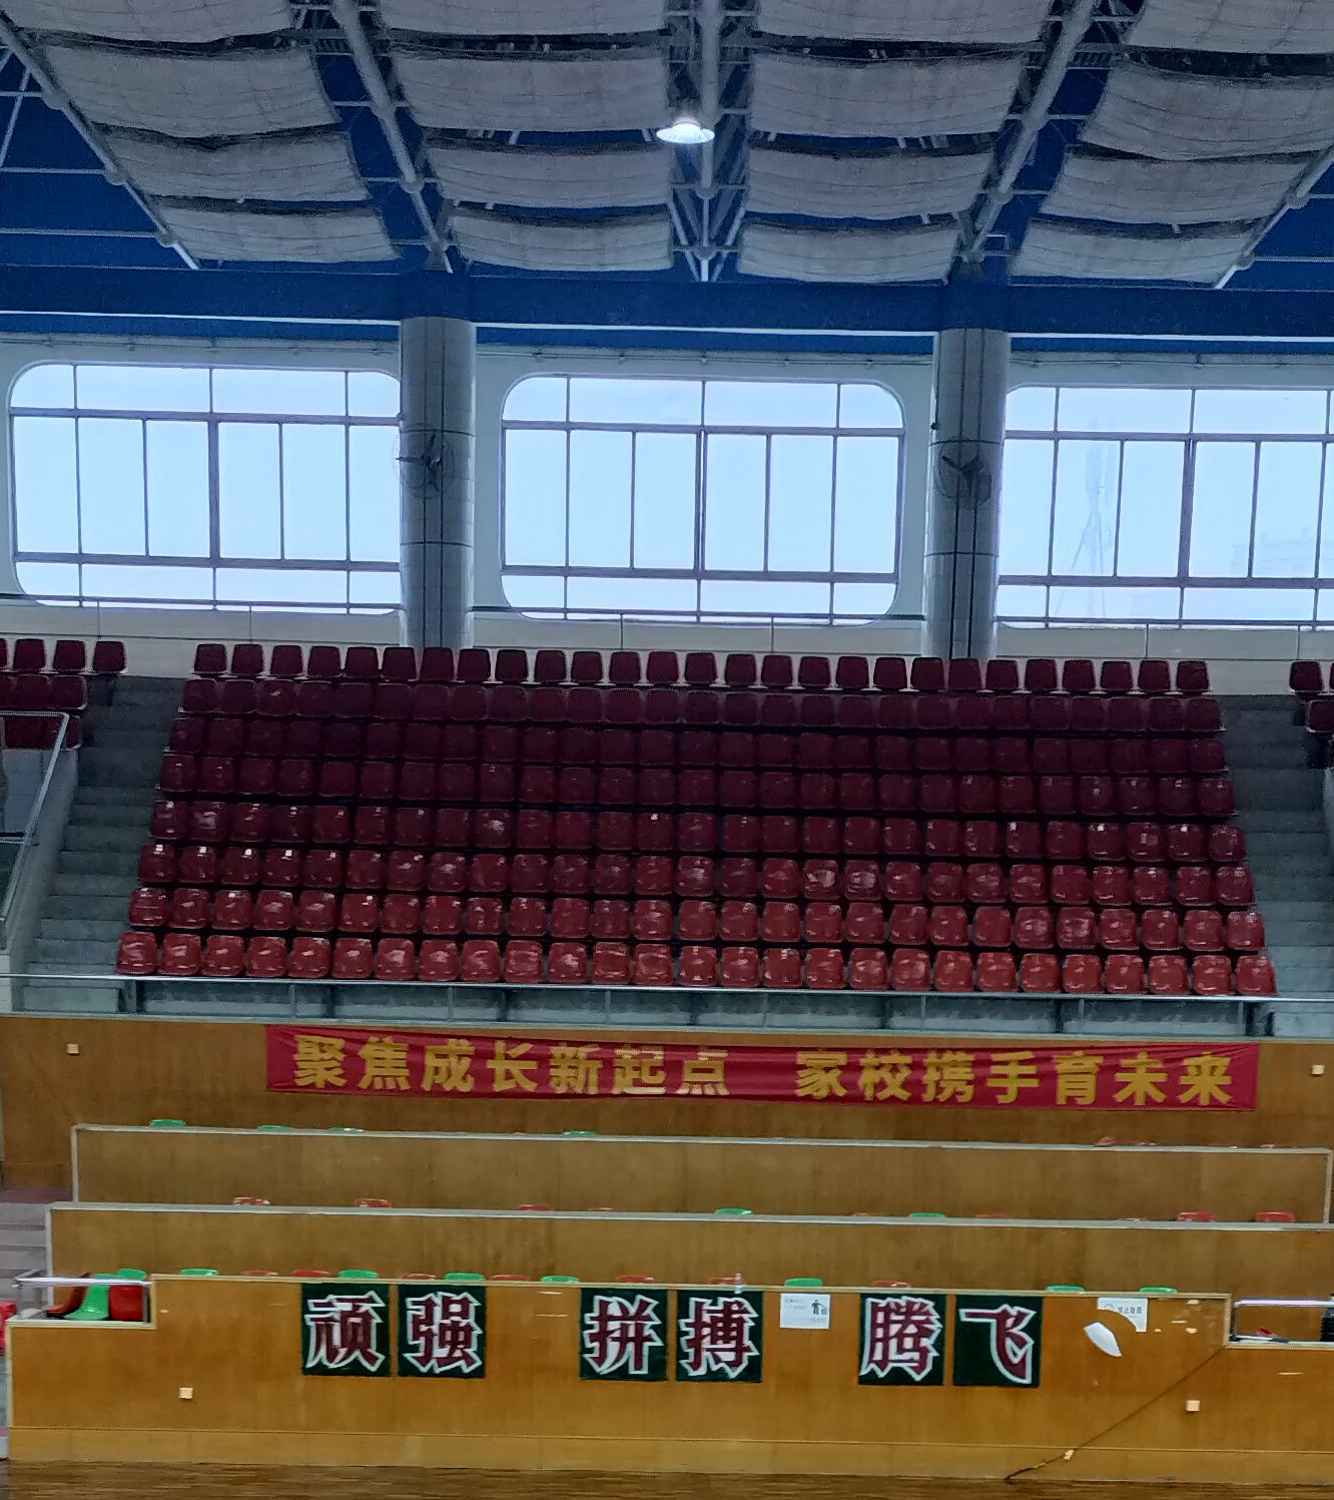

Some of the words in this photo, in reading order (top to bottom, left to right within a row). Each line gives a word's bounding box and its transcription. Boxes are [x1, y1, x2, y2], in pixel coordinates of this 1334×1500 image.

[292, 1034, 731, 1096] 聚焦成长新起点
[794, 1049, 1233, 1105] 家校携手育未来
[303, 1290, 483, 1373] 顽强
[579, 1294, 764, 1378] 拼搏
[859, 1296, 1037, 1384] 腾飞
